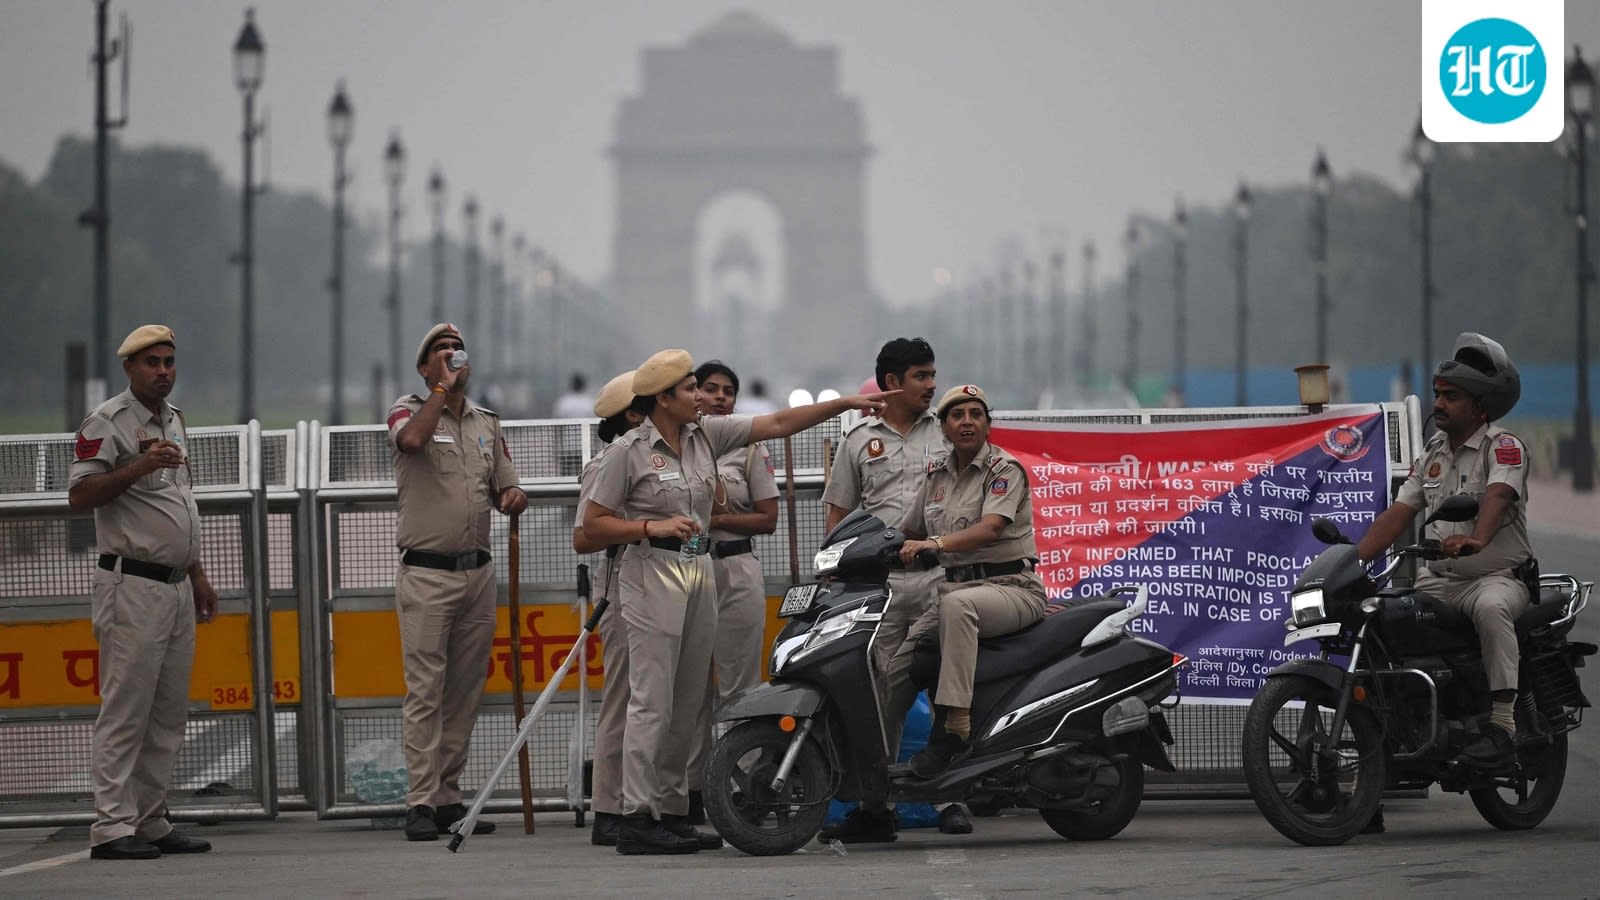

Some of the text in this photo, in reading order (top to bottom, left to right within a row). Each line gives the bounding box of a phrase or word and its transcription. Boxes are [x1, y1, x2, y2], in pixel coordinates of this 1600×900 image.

[1247, 459, 1275, 477] यहाँ
[1285, 465, 1307, 481] पर
[1033, 480, 1082, 499] संहिता
[1090, 476, 1112, 493] की
[1161, 478, 1194, 490] 163
[1201, 479, 1235, 499] लागू
[1242, 478, 1254, 497] है
[1260, 480, 1311, 502] जिसके
[1315, 490, 1375, 508] अनुसार
[1041, 503, 1081, 518] धरना
[1089, 501, 1108, 515] या
[1115, 494, 1169, 514] प्रदर्शन
[1176, 494, 1223, 514] वर्जित
[1259, 505, 1304, 525] इसका
[1041, 517, 1110, 540] कार्यवाही
[1115, 517, 1138, 535] की
[1086, 547, 1177, 561] INFORMED
[1191, 546, 1233, 562] THAT
[1247, 551, 1318, 569] PROCLA
[1049, 567, 1074, 583] 163
[1079, 565, 1124, 579] BNSS
[1129, 565, 1163, 578] HAS
[1168, 565, 1213, 579] BEEN
[1217, 566, 1288, 588] IMPOSED
[1080, 582, 1104, 598] OR
[1258, 591, 1274, 605] IS
[1183, 602, 1199, 617] IN
[1207, 604, 1251, 622] CASE
[1259, 608, 1282, 621] OF
[1198, 645, 1265, 661] आदेशानुसार
[1191, 659, 1223, 674] पुलिस
[1227, 662, 1249, 676] /Dy.
[1187, 674, 1220, 687] दिल्ली
[1226, 675, 1255, 689] जिला
[214, 686, 250, 705] 384
